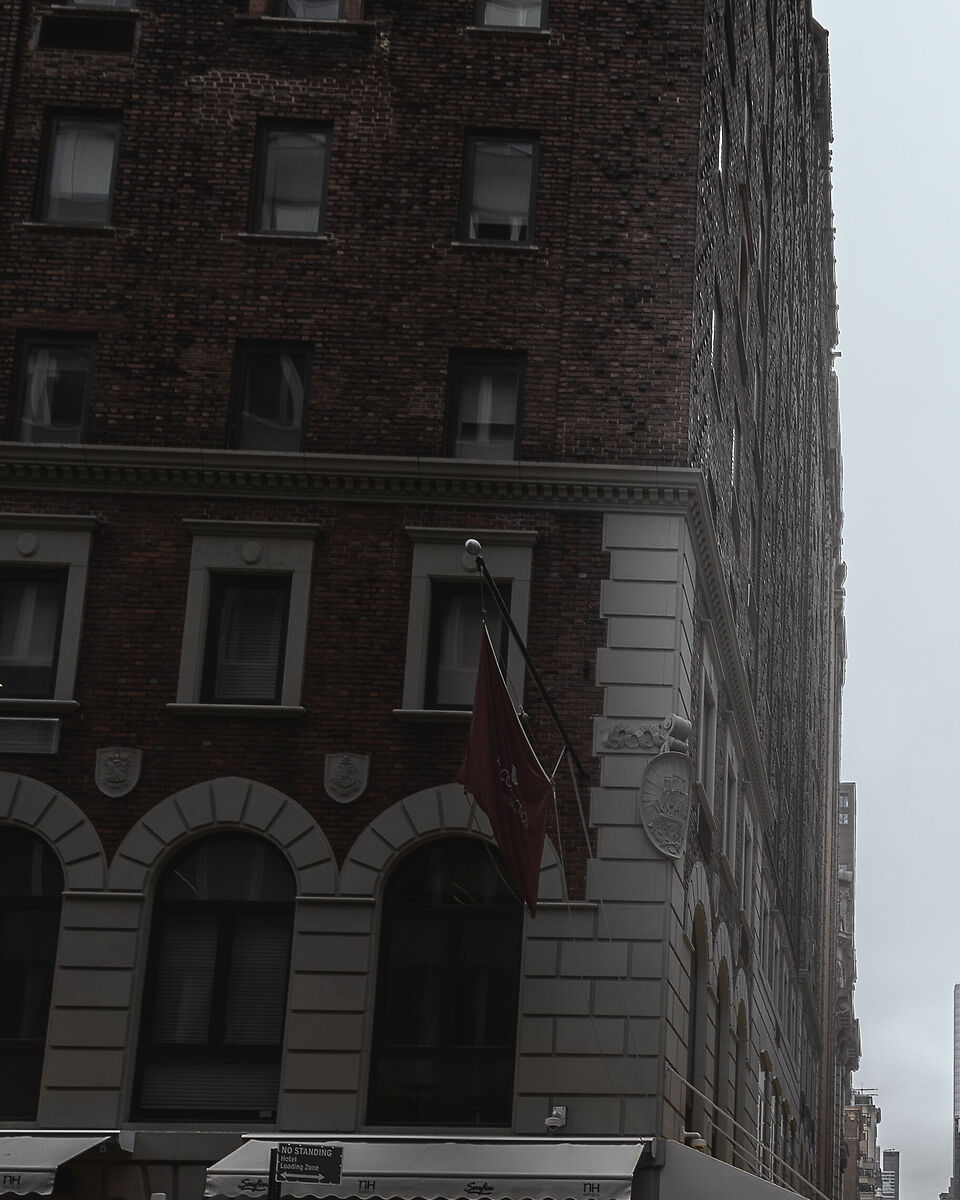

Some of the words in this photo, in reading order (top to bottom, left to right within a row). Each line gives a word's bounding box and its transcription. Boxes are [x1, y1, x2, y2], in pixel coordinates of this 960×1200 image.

[281, 1146, 293, 1155] NO
[294, 1147, 332, 1157] STANDING
[280, 1155, 297, 1163] Hotel
[280, 1163, 303, 1171] Loading
